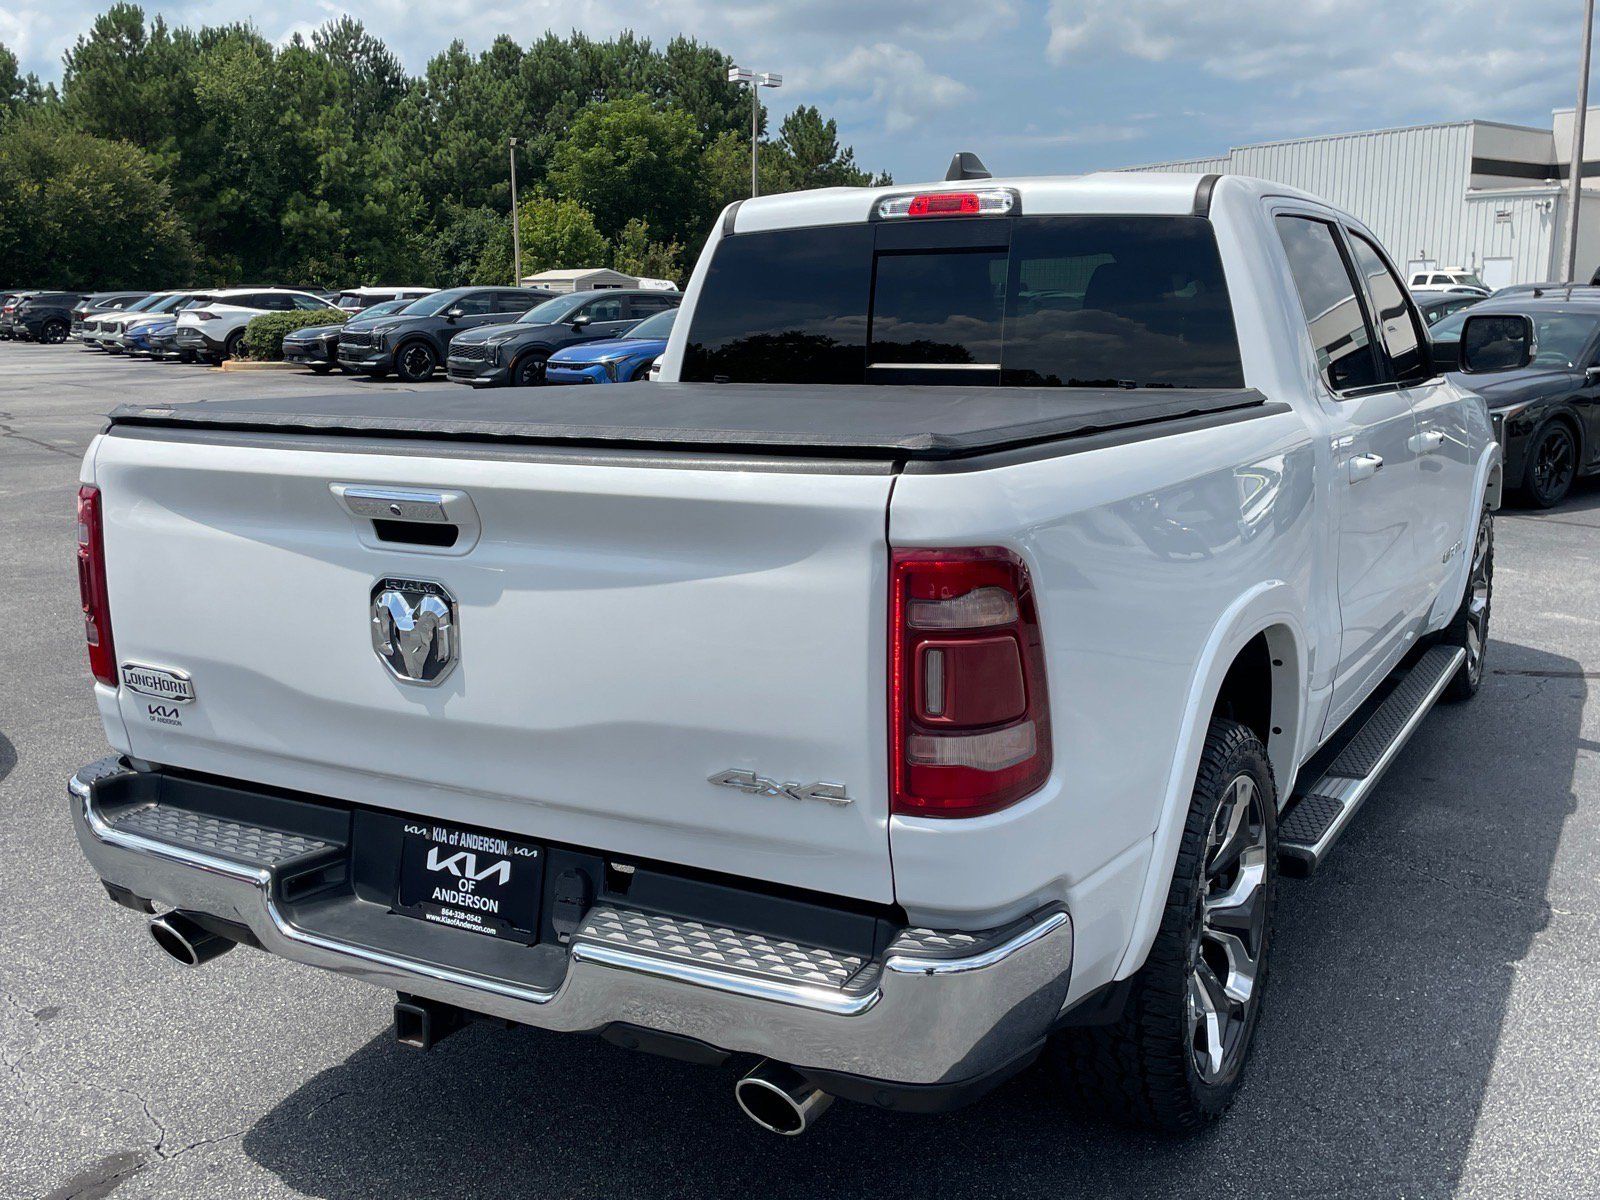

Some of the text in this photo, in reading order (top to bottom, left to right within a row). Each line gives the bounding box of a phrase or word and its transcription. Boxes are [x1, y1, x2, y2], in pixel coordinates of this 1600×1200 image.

[385, 579, 437, 593] RAM
[432, 826, 508, 856] KIA of ANDERSON
[426, 846, 511, 886] KIA
[458, 878, 476, 893] OF
[431, 886, 499, 914] ANDERSON
[425, 912, 497, 935] www.KiaofAnderson.com
[441, 907, 482, 924] 864-328-0542
